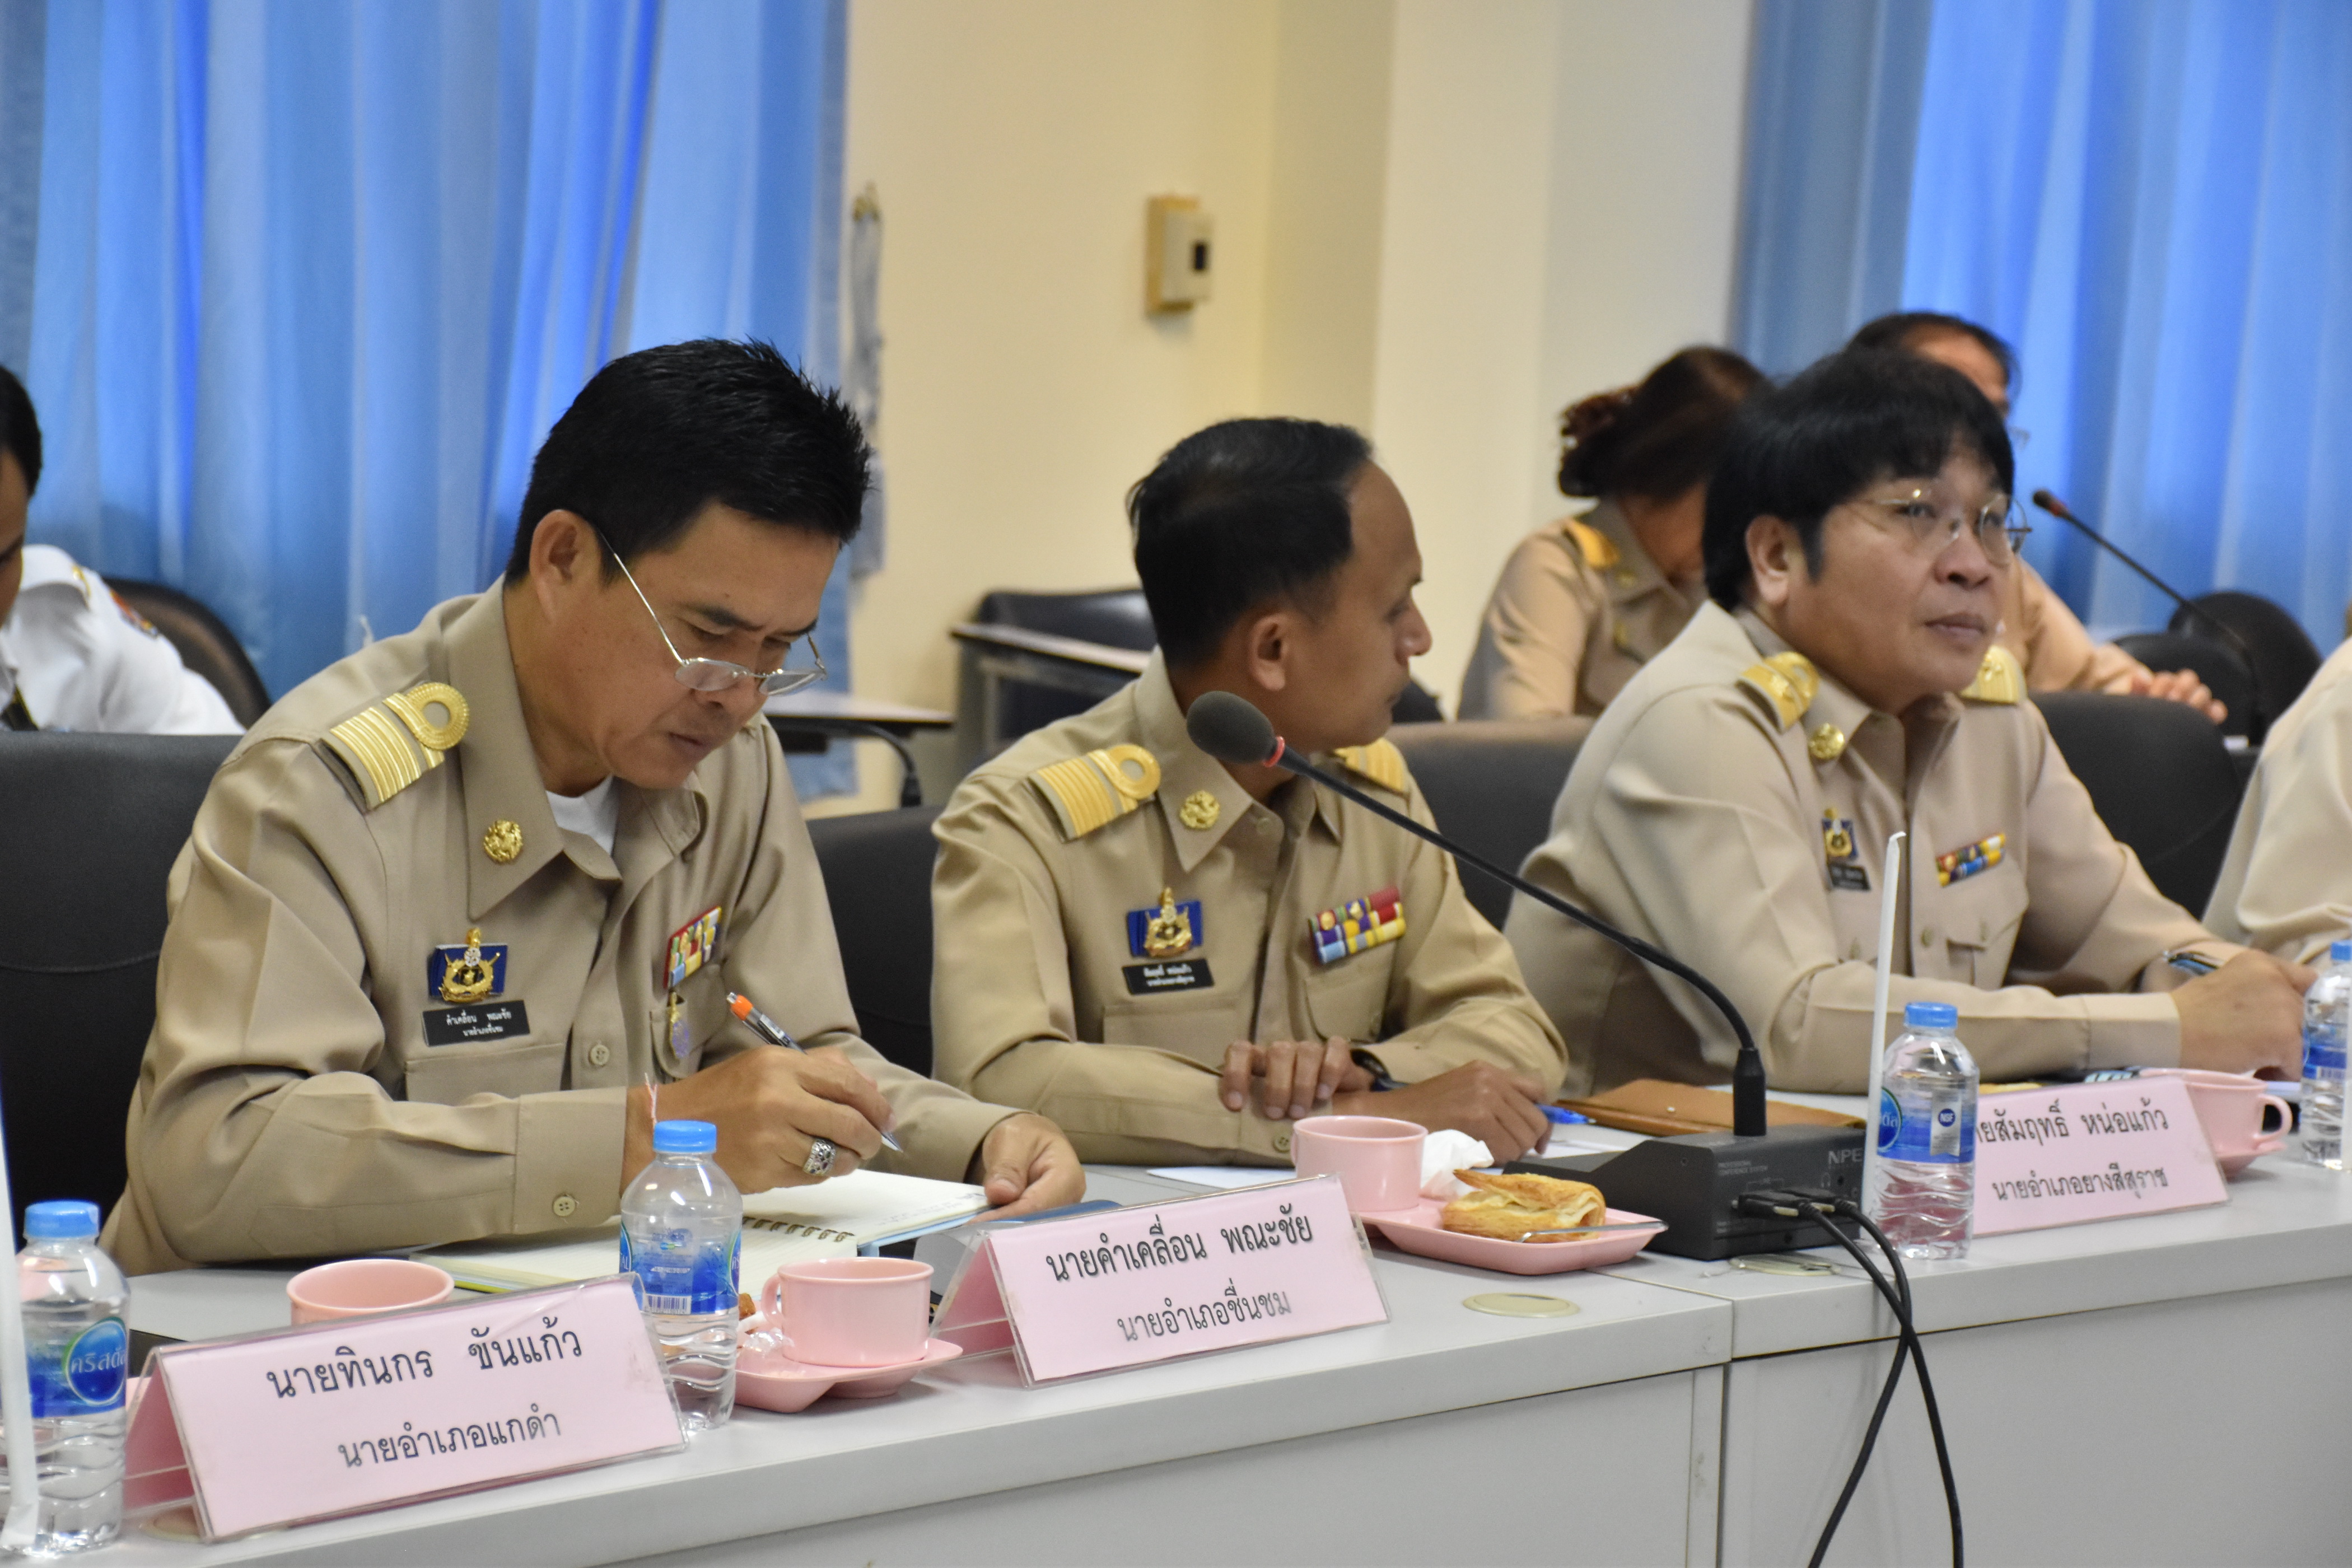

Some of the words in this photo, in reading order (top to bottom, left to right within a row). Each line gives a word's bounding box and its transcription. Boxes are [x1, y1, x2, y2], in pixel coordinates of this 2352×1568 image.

[1976, 1098, 2070, 1146] ายสัมฤทธิ์
[2080, 1096, 2169, 1136] หน่อแก้ว
[1992, 1162, 2168, 1200] นายอำเภอยางสีสุราช
[1046, 1214, 1208, 1282] นายคำเคลื่อน
[1220, 1203, 1313, 1254] พณะชัย
[1117, 1277, 1292, 1342] นายอำเภอชื่นชม
[266, 1345, 433, 1399] นายทินกร
[468, 1316, 582, 1370] ขันแก้ว
[337, 1403, 561, 1468] นายอำเภอแกดำ
